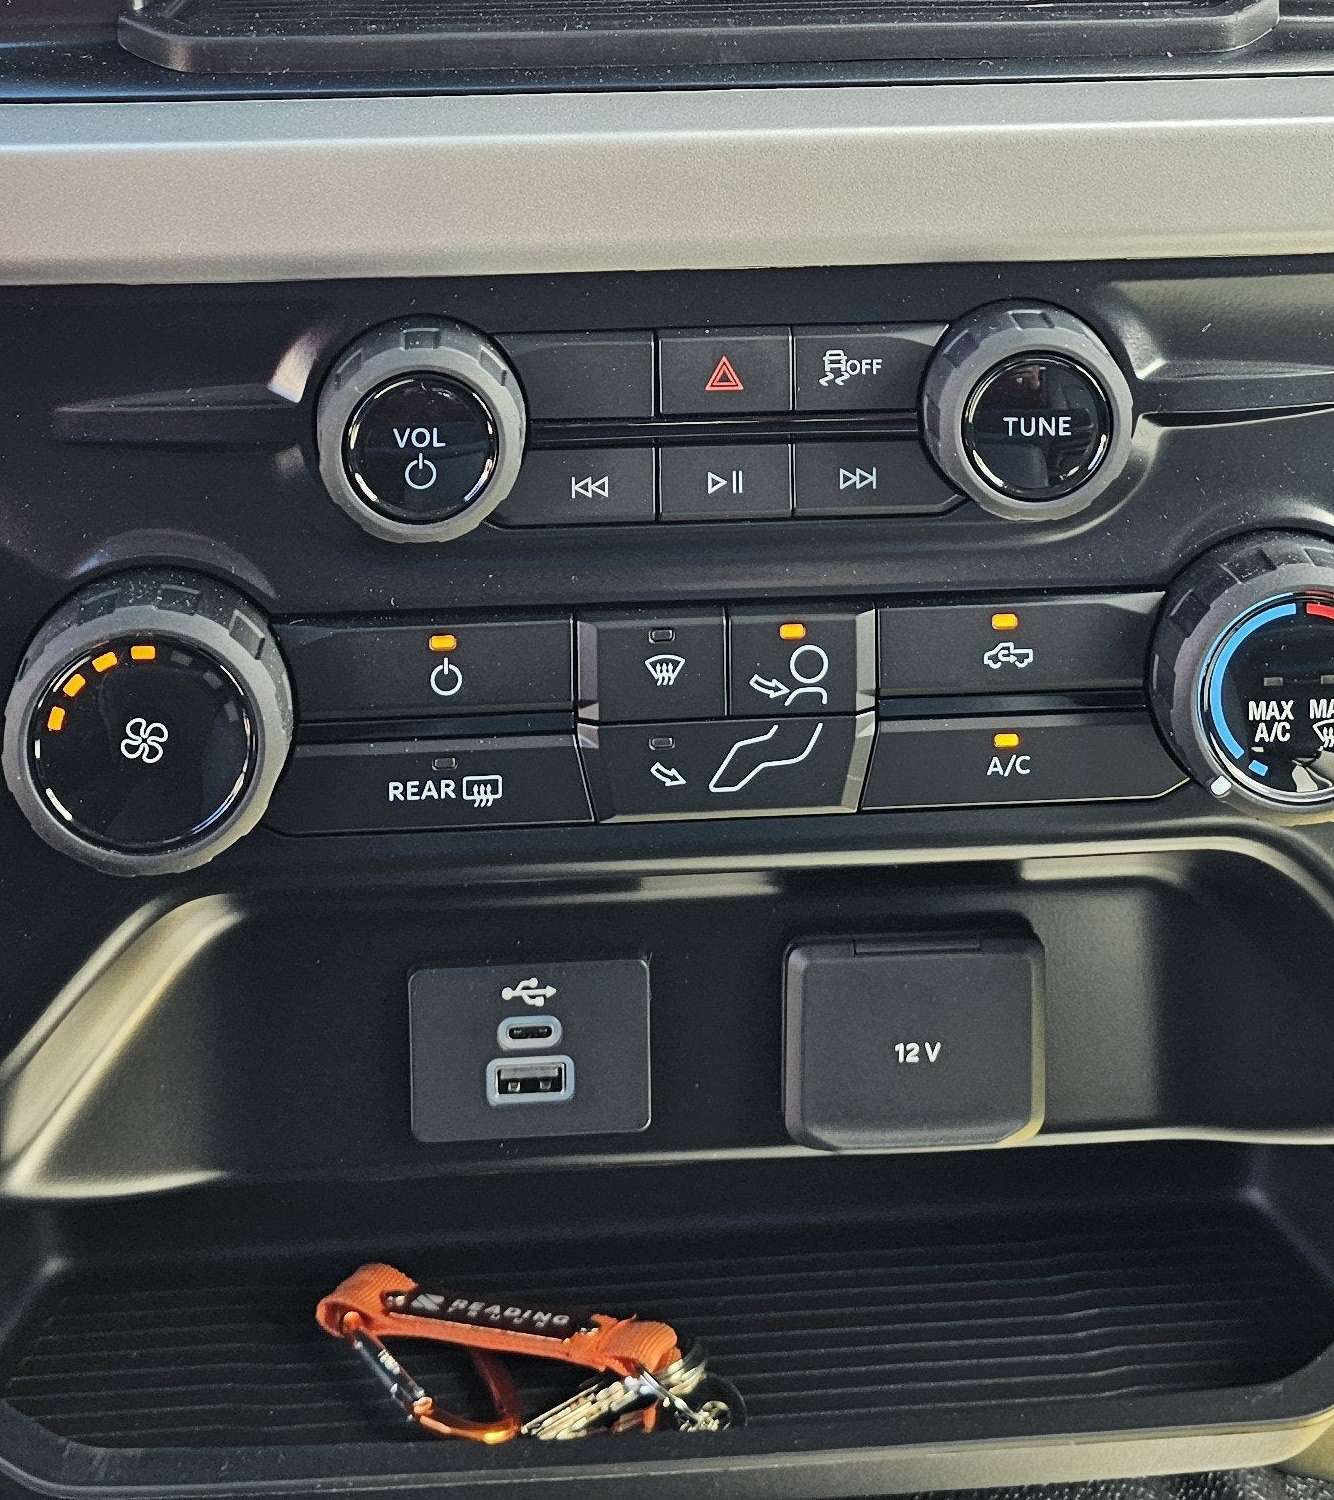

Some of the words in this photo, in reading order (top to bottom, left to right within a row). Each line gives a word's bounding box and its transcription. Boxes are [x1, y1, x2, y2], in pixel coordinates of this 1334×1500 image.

[845, 356, 884, 377] OFF
[392, 426, 447, 450] VOL
[1002, 415, 1072, 438] TUNE
[1248, 699, 1295, 721] MAX
[1254, 721, 1291, 743] A/C
[986, 754, 1032, 778] A/C
[387, 778, 457, 802] REAR
[893, 1042, 920, 1065] 12
[923, 1041, 942, 1063] V
